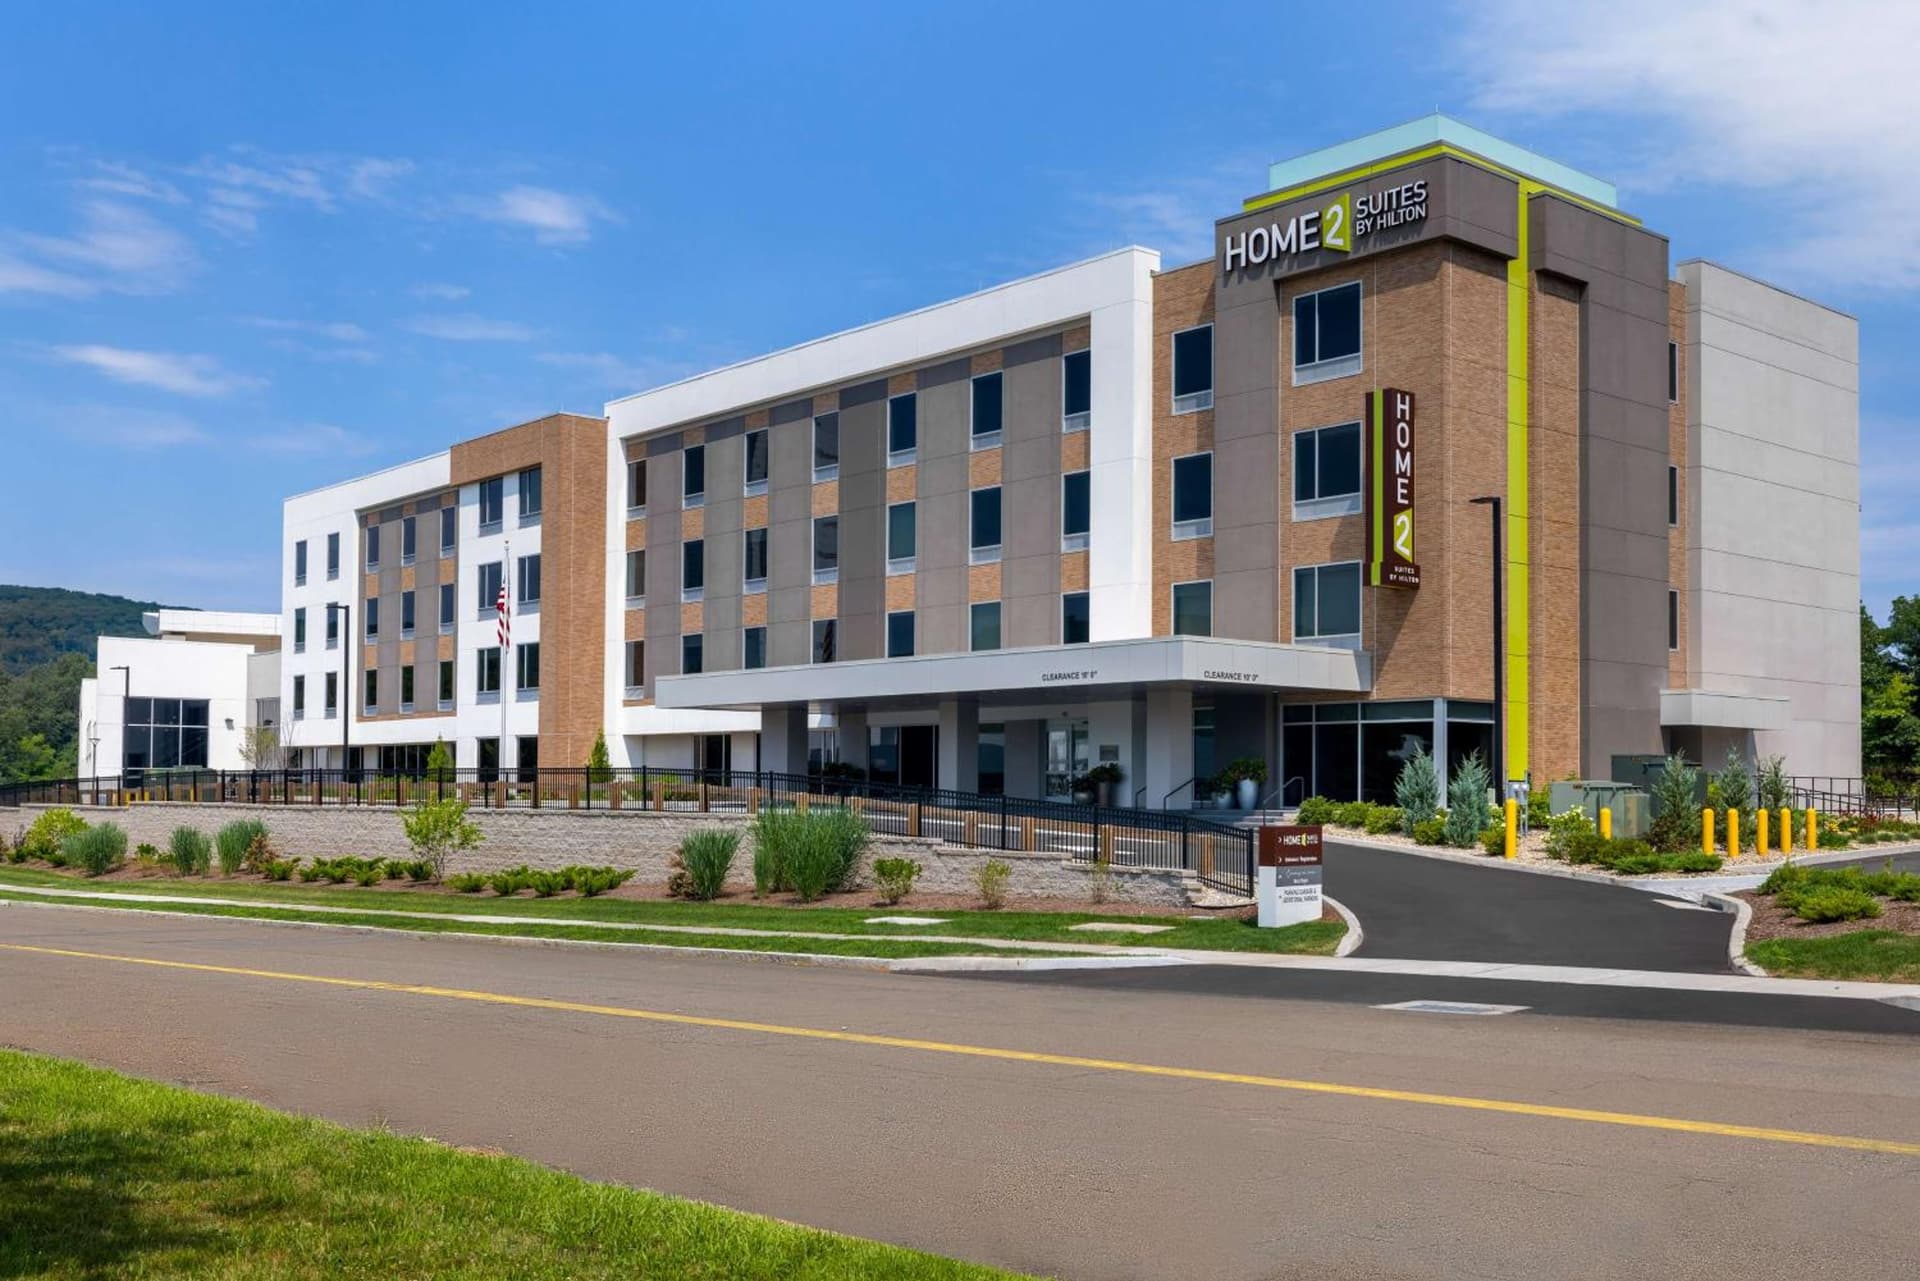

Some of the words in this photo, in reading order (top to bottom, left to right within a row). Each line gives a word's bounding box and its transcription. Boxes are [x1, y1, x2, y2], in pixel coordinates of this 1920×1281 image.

[1355, 180, 1427, 219] SUITES
[1356, 216, 1375, 236] BY
[1376, 204, 1426, 231] HILTON
[1041, 671, 1081, 681] CLEARANCE
[1204, 670, 1242, 681] CLEARANCE
